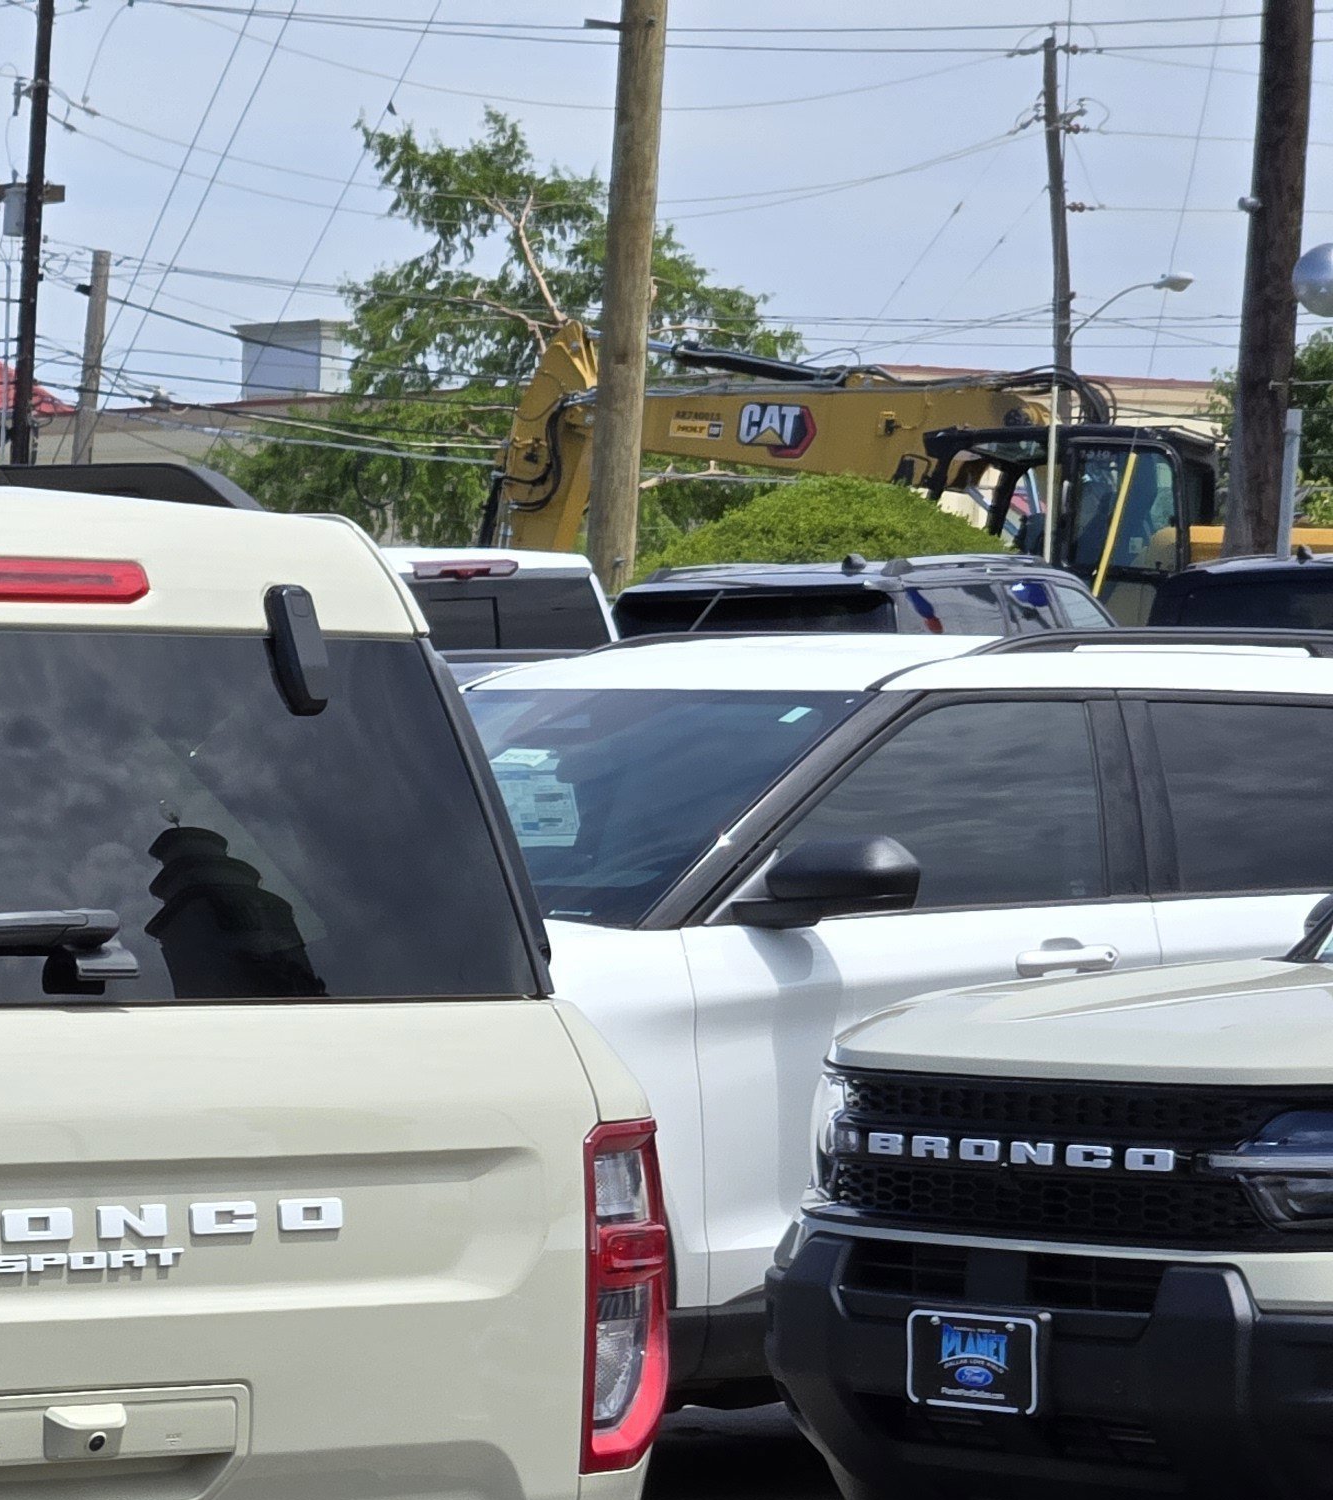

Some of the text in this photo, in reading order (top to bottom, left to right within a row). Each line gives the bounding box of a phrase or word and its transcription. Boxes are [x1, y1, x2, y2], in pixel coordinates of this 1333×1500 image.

[739, 404, 801, 446] CAT
[868, 1132, 1175, 1172] BRONCO
[941, 1323, 1007, 1366] PLANET
